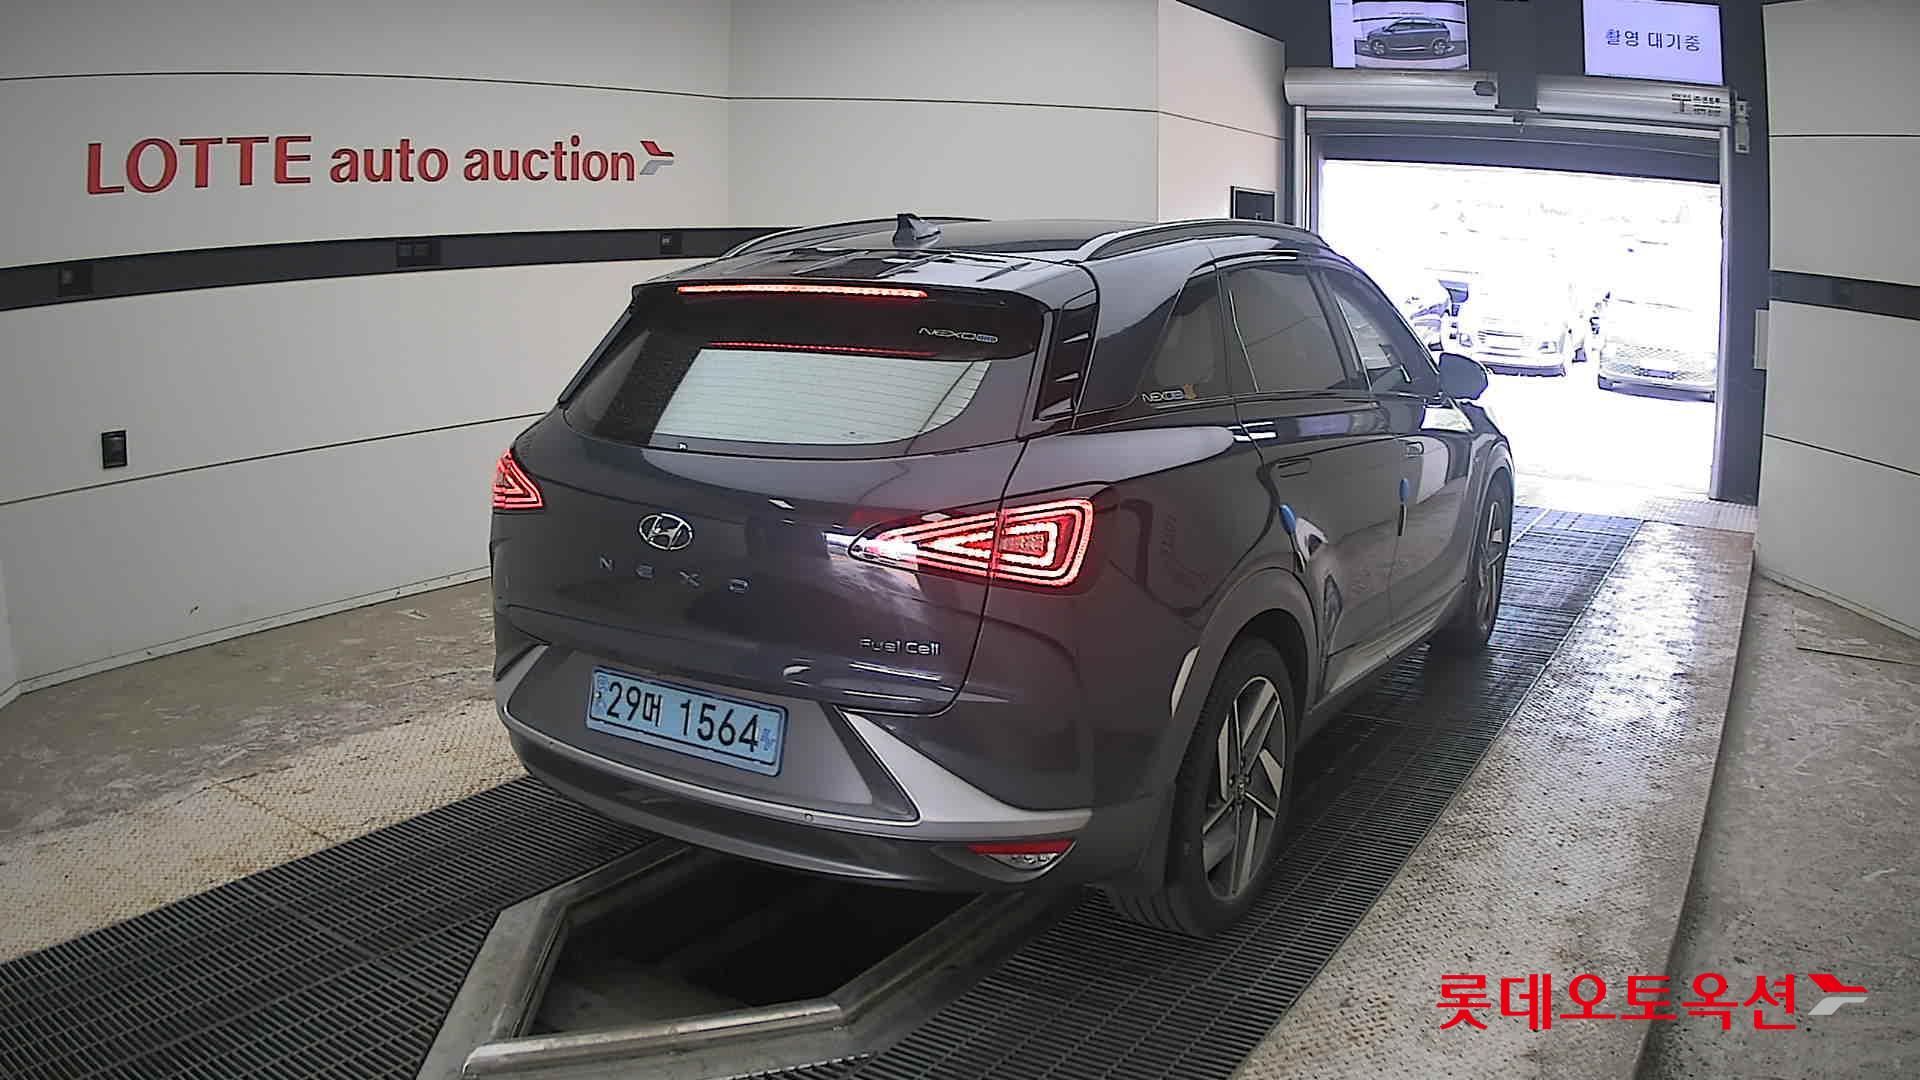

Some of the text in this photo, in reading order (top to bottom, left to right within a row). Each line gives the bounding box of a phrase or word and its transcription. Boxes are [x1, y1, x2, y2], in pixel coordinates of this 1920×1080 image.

[1648, 31, 1701, 52] 대기중
[86, 135, 636, 195] LOTTE auto auction
[859, 637, 940, 656] Fuel Cell
[606, 681, 663, 728] 29머
[680, 698, 759, 753] 1564
